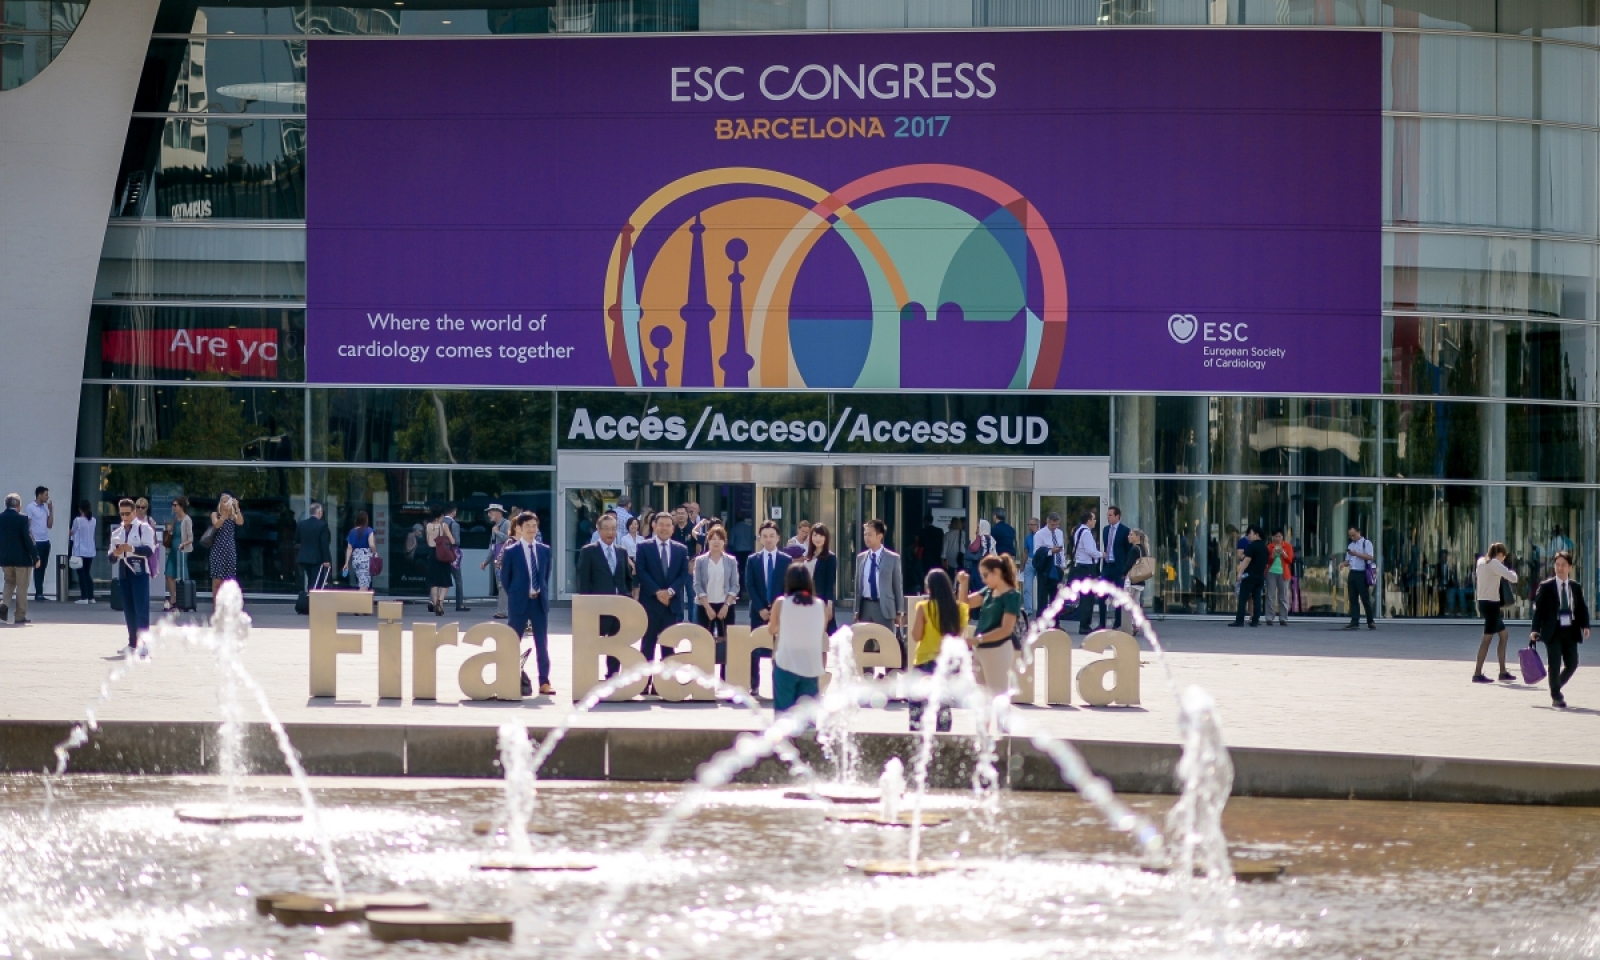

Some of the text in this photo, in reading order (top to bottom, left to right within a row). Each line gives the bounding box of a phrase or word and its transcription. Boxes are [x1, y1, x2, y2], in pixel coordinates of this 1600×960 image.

[671, 62, 997, 102] ESC CONGRESS
[715, 116, 951, 140] BARCELONA 2017
[367, 313, 548, 331] Where the world of
[1203, 322, 1249, 342] ESC
[170, 329, 228, 357] Are
[338, 340, 575, 363] cardiology comes together
[1203, 346, 1286, 359] European Society
[1203, 358, 1266, 370] of Cardiology
[976, 415, 1049, 445] SUD
[309, 590, 521, 700] Fira
